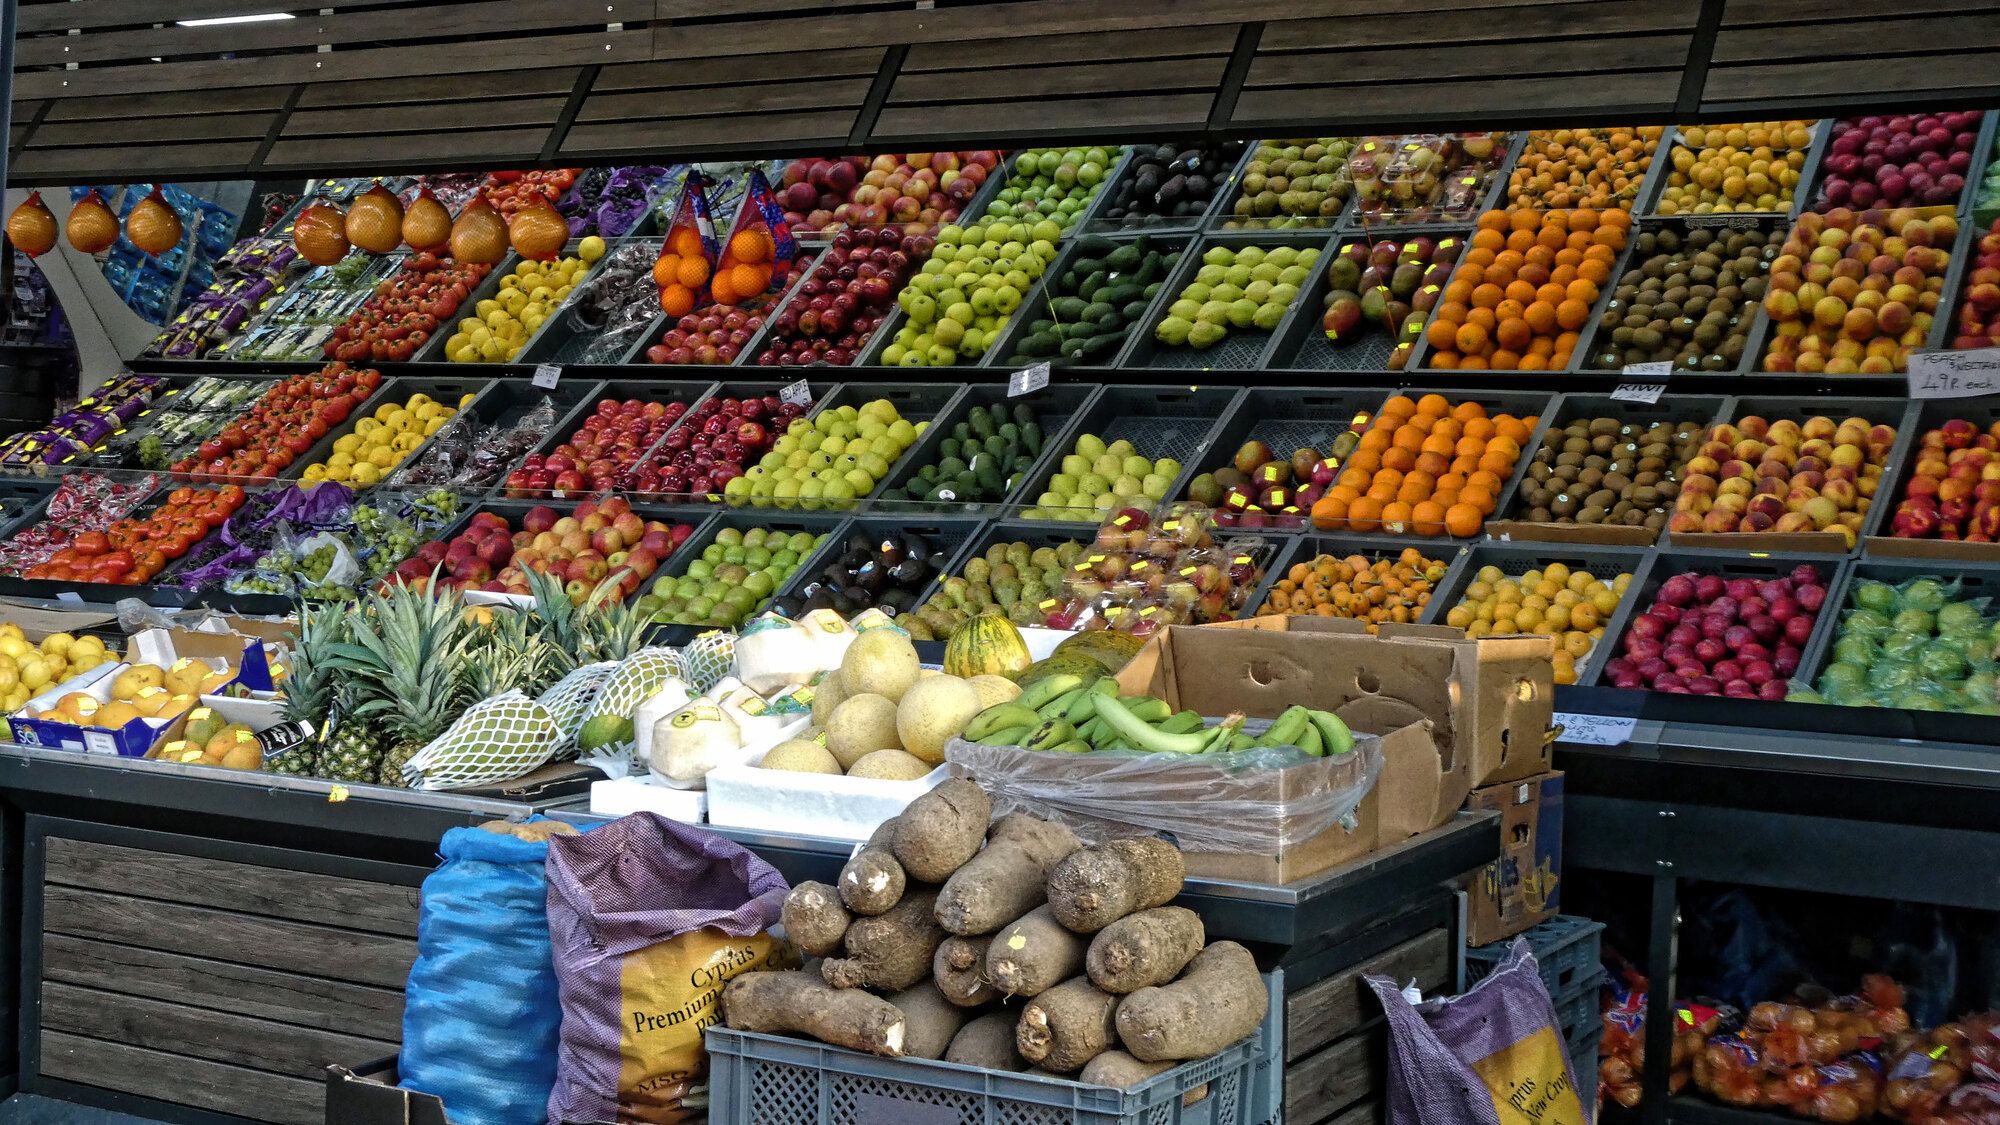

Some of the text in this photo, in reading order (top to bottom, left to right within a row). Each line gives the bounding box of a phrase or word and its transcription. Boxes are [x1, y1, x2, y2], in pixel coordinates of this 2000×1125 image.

[1581, 716, 1632, 726] YELLOW
[17, 730, 43, 746] SOL
[691, 945, 755, 988] Cyprus
[632, 987, 718, 1033] Premium
